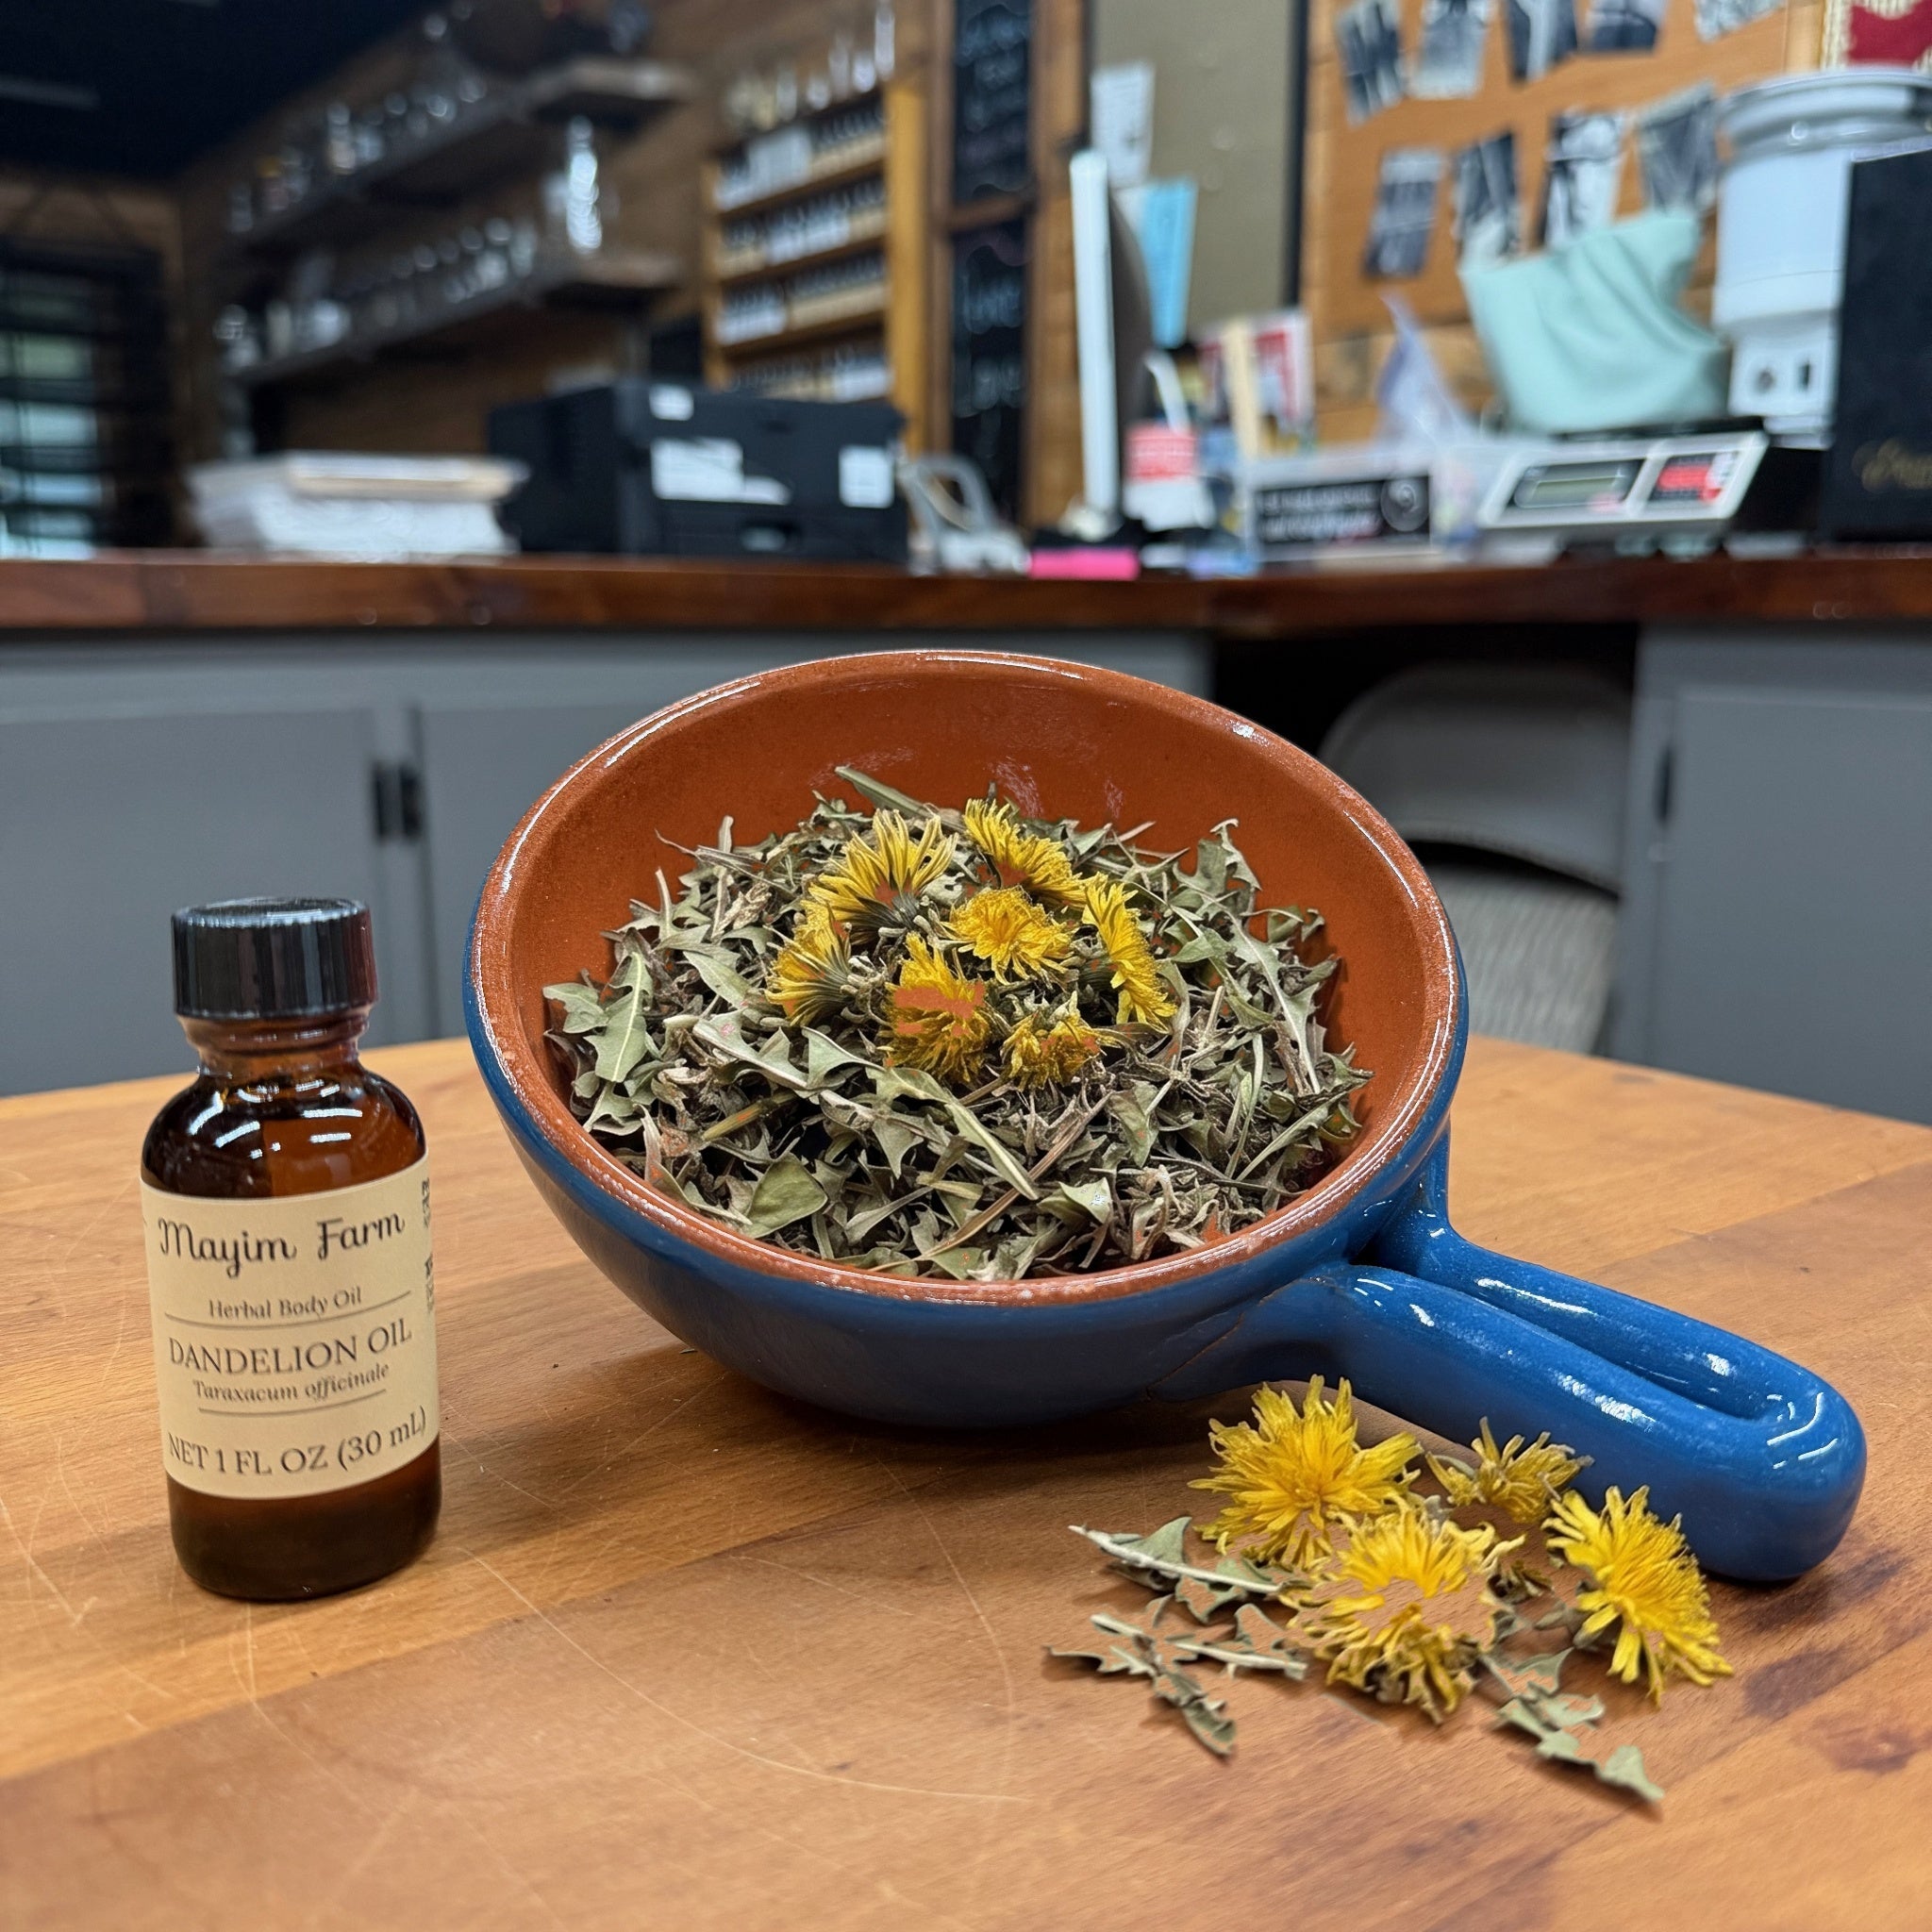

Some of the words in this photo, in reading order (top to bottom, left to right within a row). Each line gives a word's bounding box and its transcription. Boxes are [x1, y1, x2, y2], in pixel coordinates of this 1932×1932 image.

[158, 1217, 298, 1280] Mayim
[316, 1211, 406, 1261] Farm
[208, 1299, 272, 1320] Herbal
[279, 1295, 328, 1319] Body
[333, 1286, 362, 1309] Oil
[168, 1336, 358, 1374] DANDELION
[367, 1317, 412, 1356] OIL
[192, 1378, 298, 1404] Taraxacum
[304, 1362, 391, 1401] officinale
[168, 1431, 208, 1471] NET
[215, 1449, 226, 1473] 1
[235, 1449, 273, 1475] FL
[280, 1444, 329, 1474] OZ
[337, 1429, 382, 1472] (30
[389, 1405, 427, 1448] mL)
